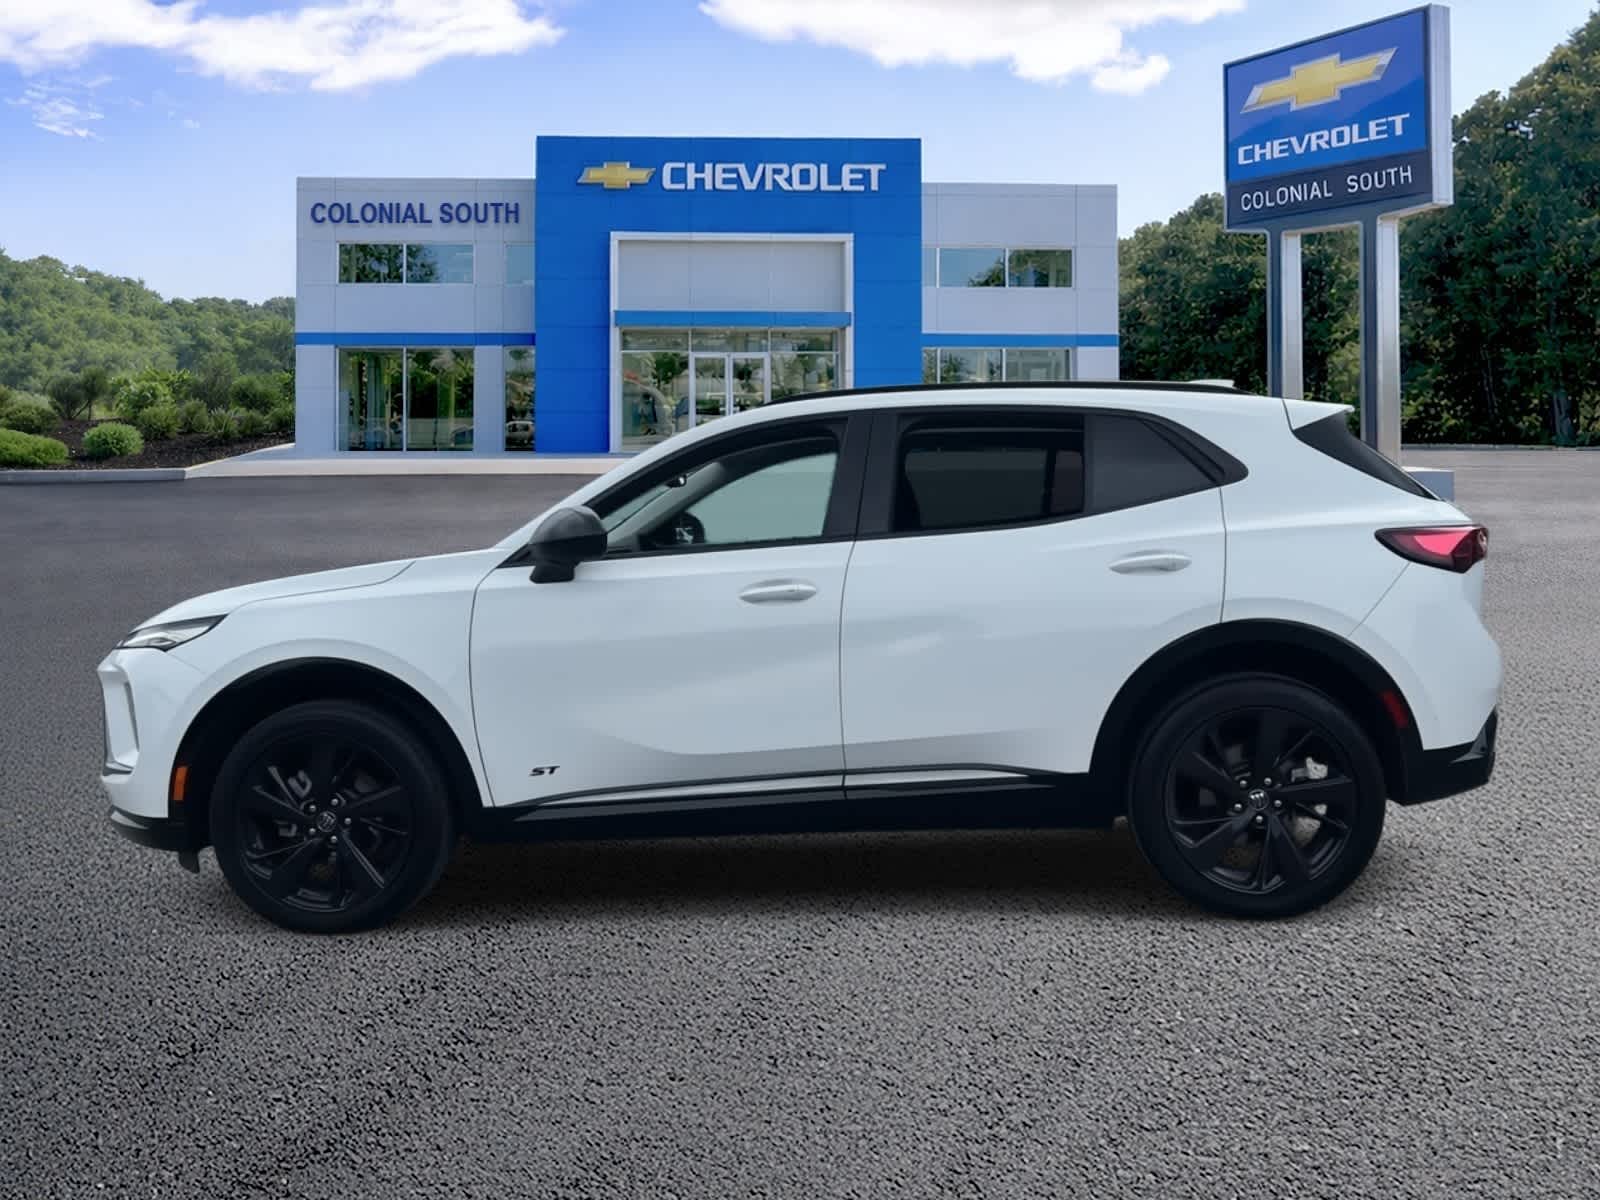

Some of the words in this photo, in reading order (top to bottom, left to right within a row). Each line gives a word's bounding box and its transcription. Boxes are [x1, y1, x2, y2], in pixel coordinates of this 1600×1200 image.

[1238, 113, 1410, 165] CHEVROLET
[662, 162, 886, 191] CHEVROLET
[1241, 180, 1332, 211] COLONIAL
[1347, 165, 1412, 193] SOUTH
[310, 202, 432, 224] COLONIAL
[439, 202, 519, 224] SOUTH
[529, 765, 560, 776] ST
